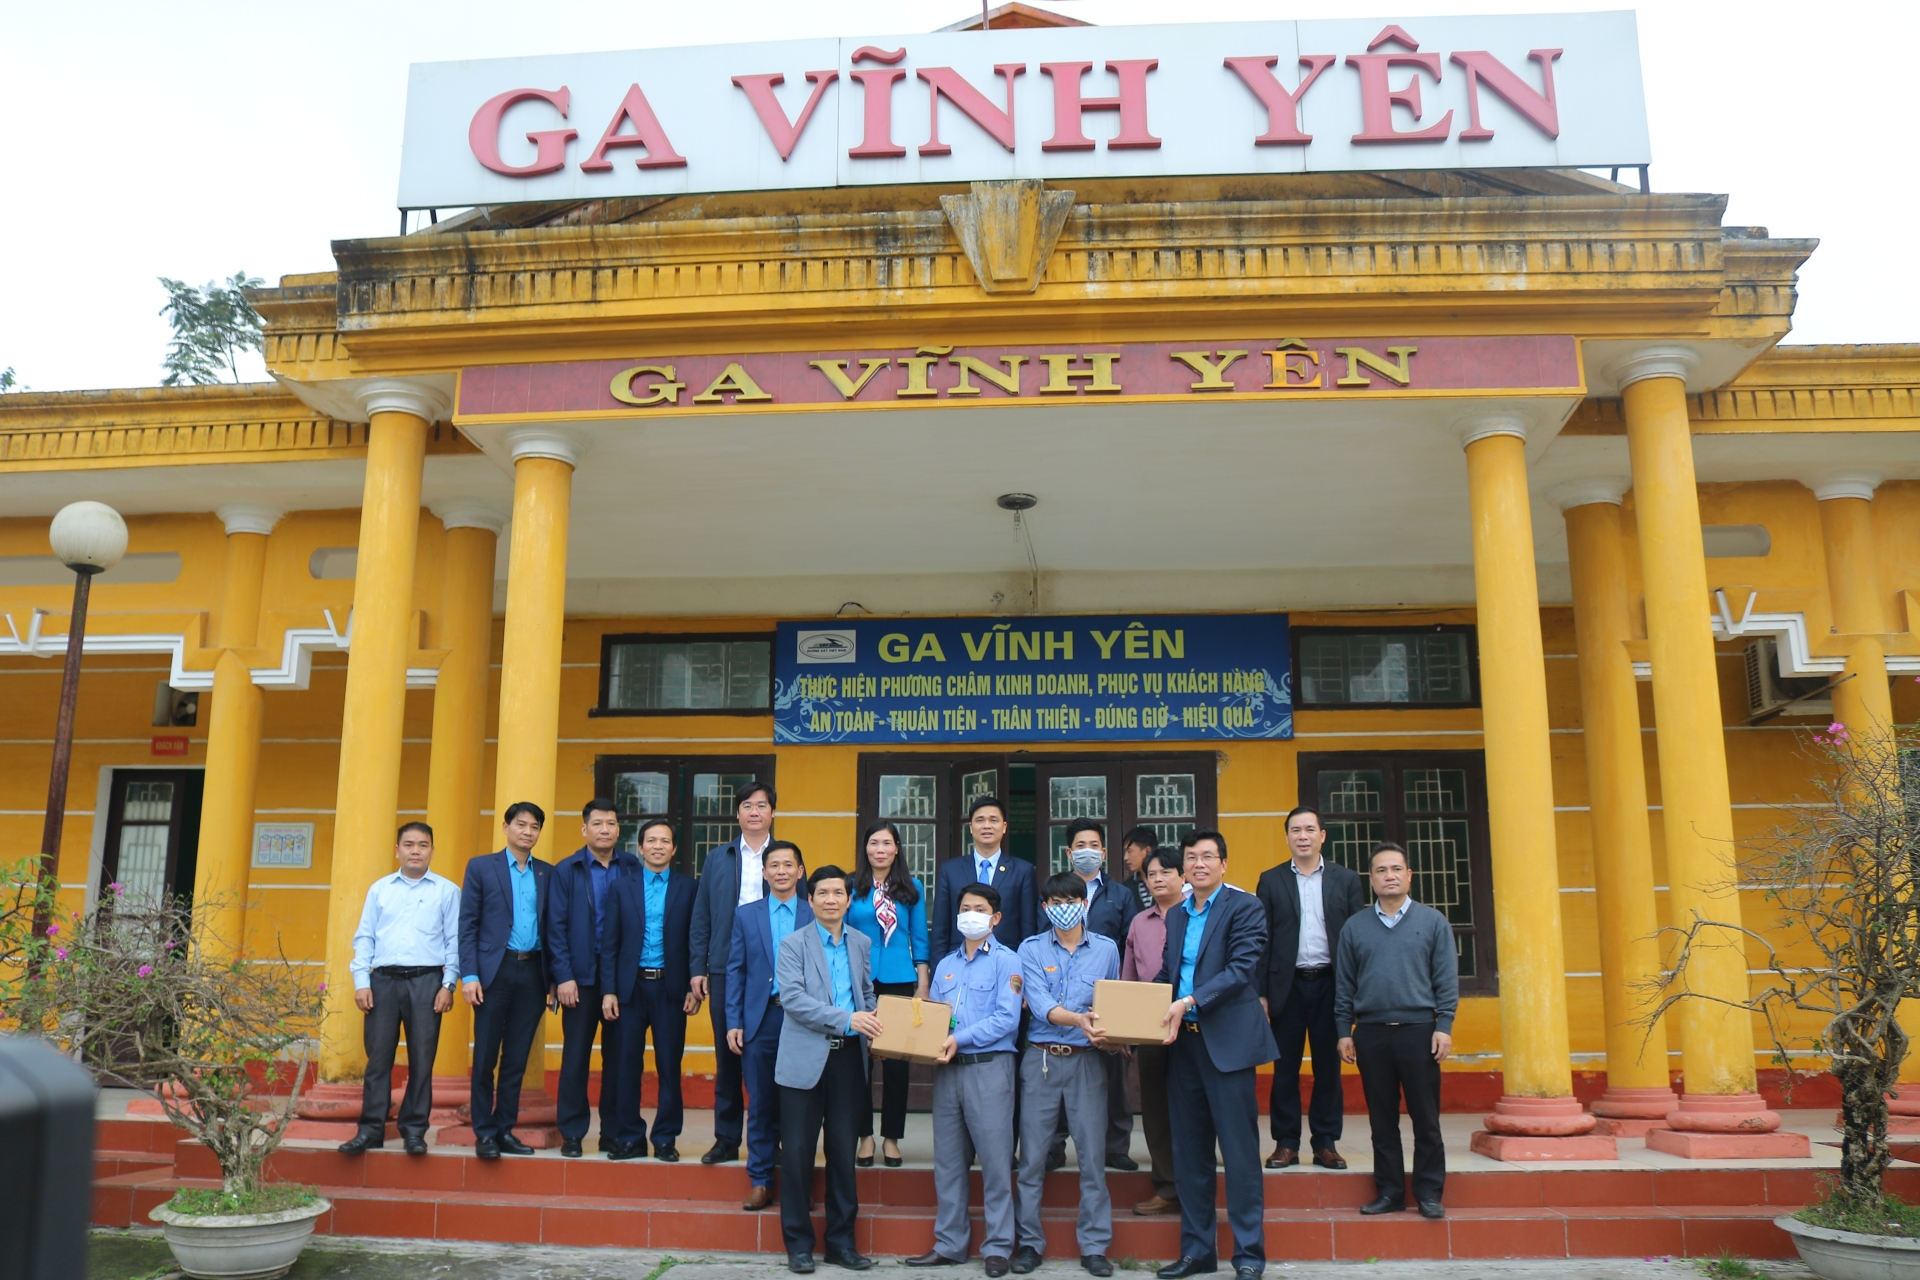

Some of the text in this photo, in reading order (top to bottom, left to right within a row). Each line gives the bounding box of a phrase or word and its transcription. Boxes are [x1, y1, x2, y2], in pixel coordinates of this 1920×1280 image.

[469, 25, 1564, 178] GA VĨNH YÊN
[609, 338, 1418, 406] GA VĨNH YÊN
[878, 622, 1185, 663] GA VĨNH YÊN
[800, 668, 1265, 702] THỰC HIỆN PHƯƠNG CHÂM KINH DOANH, PHỤC VỤ KHÁCH HÀNG
[809, 711, 832, 732] AN
[835, 706, 875, 732] TOÀN
[889, 705, 939, 736] THUẬN
[943, 705, 977, 736] TIỆN
[991, 704, 1032, 730] THÂN
[1036, 704, 1080, 734] THIỆN
[1095, 703, 1138, 729] ĐÚNG
[1142, 702, 1169, 729] GIỜ
[1183, 702, 1219, 733] HIỆU
[1222, 698, 1254, 730] QUẢ
